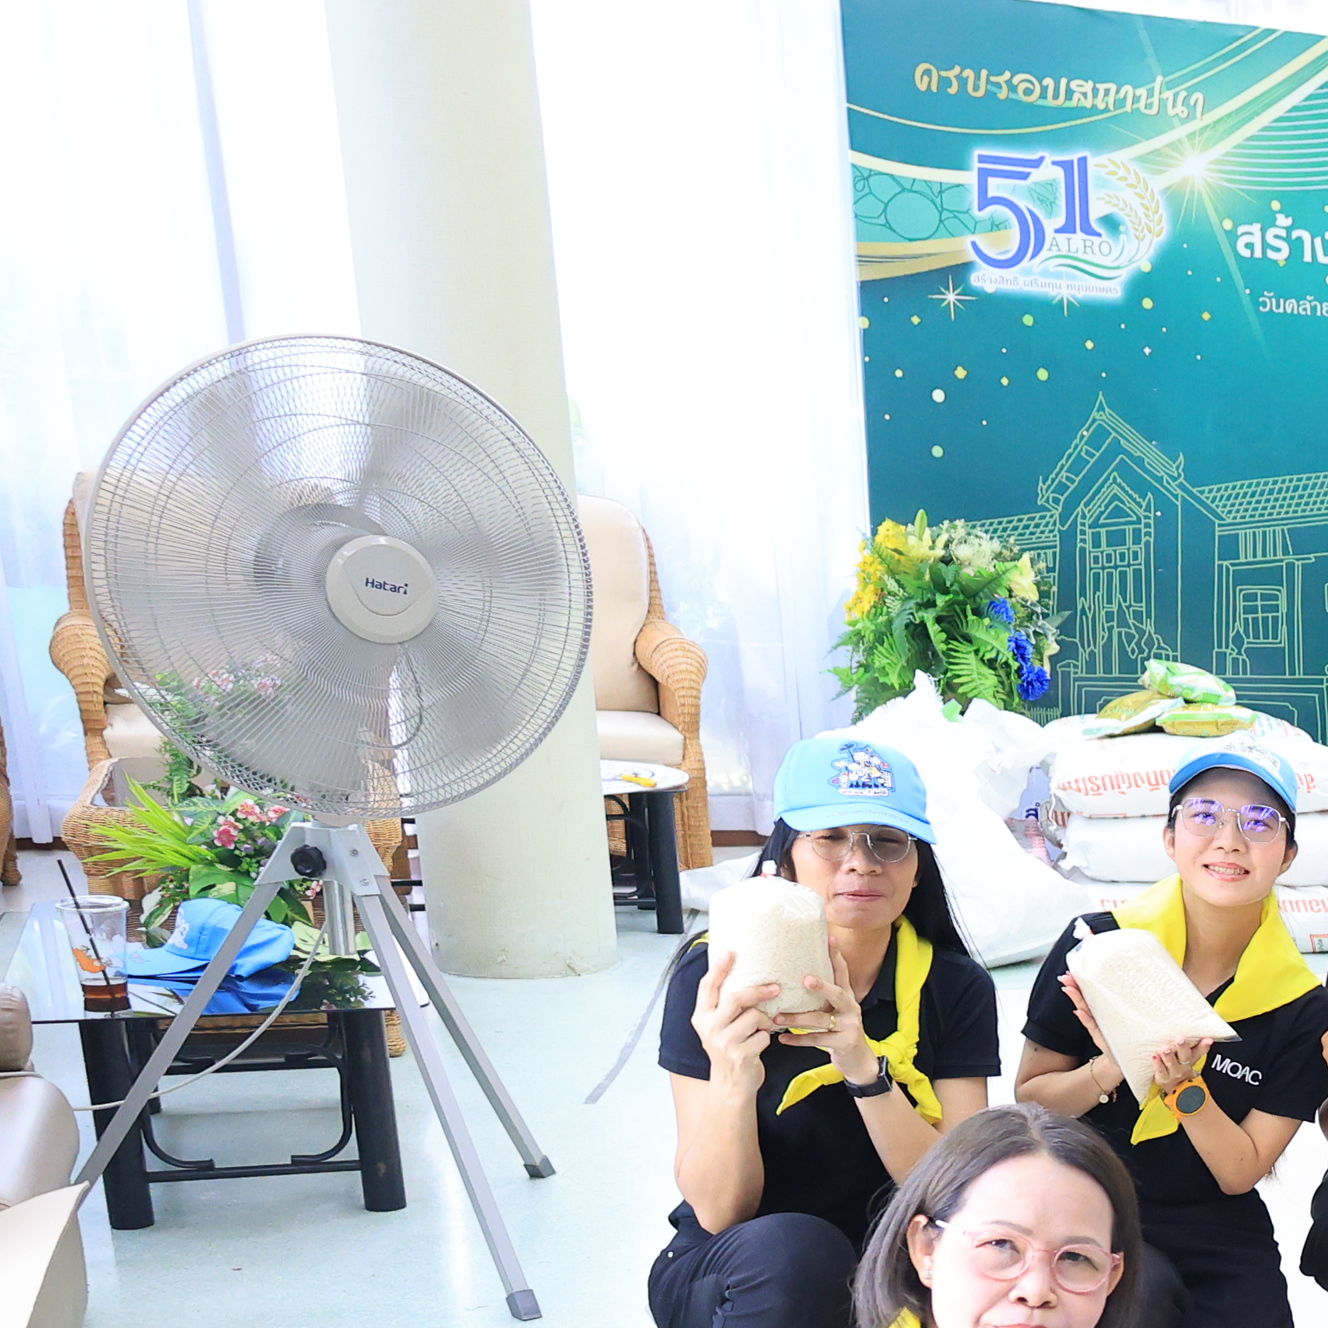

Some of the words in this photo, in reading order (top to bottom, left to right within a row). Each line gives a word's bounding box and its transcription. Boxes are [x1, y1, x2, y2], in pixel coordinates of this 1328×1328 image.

[913, 61, 1206, 121] ครบรอบสถาปนา
[970, 152, 1103, 270] 51
[1046, 236, 1113, 257] ALRO
[364, 576, 409, 595] Hatari
[1211, 1053, 1263, 1086] MOAC
